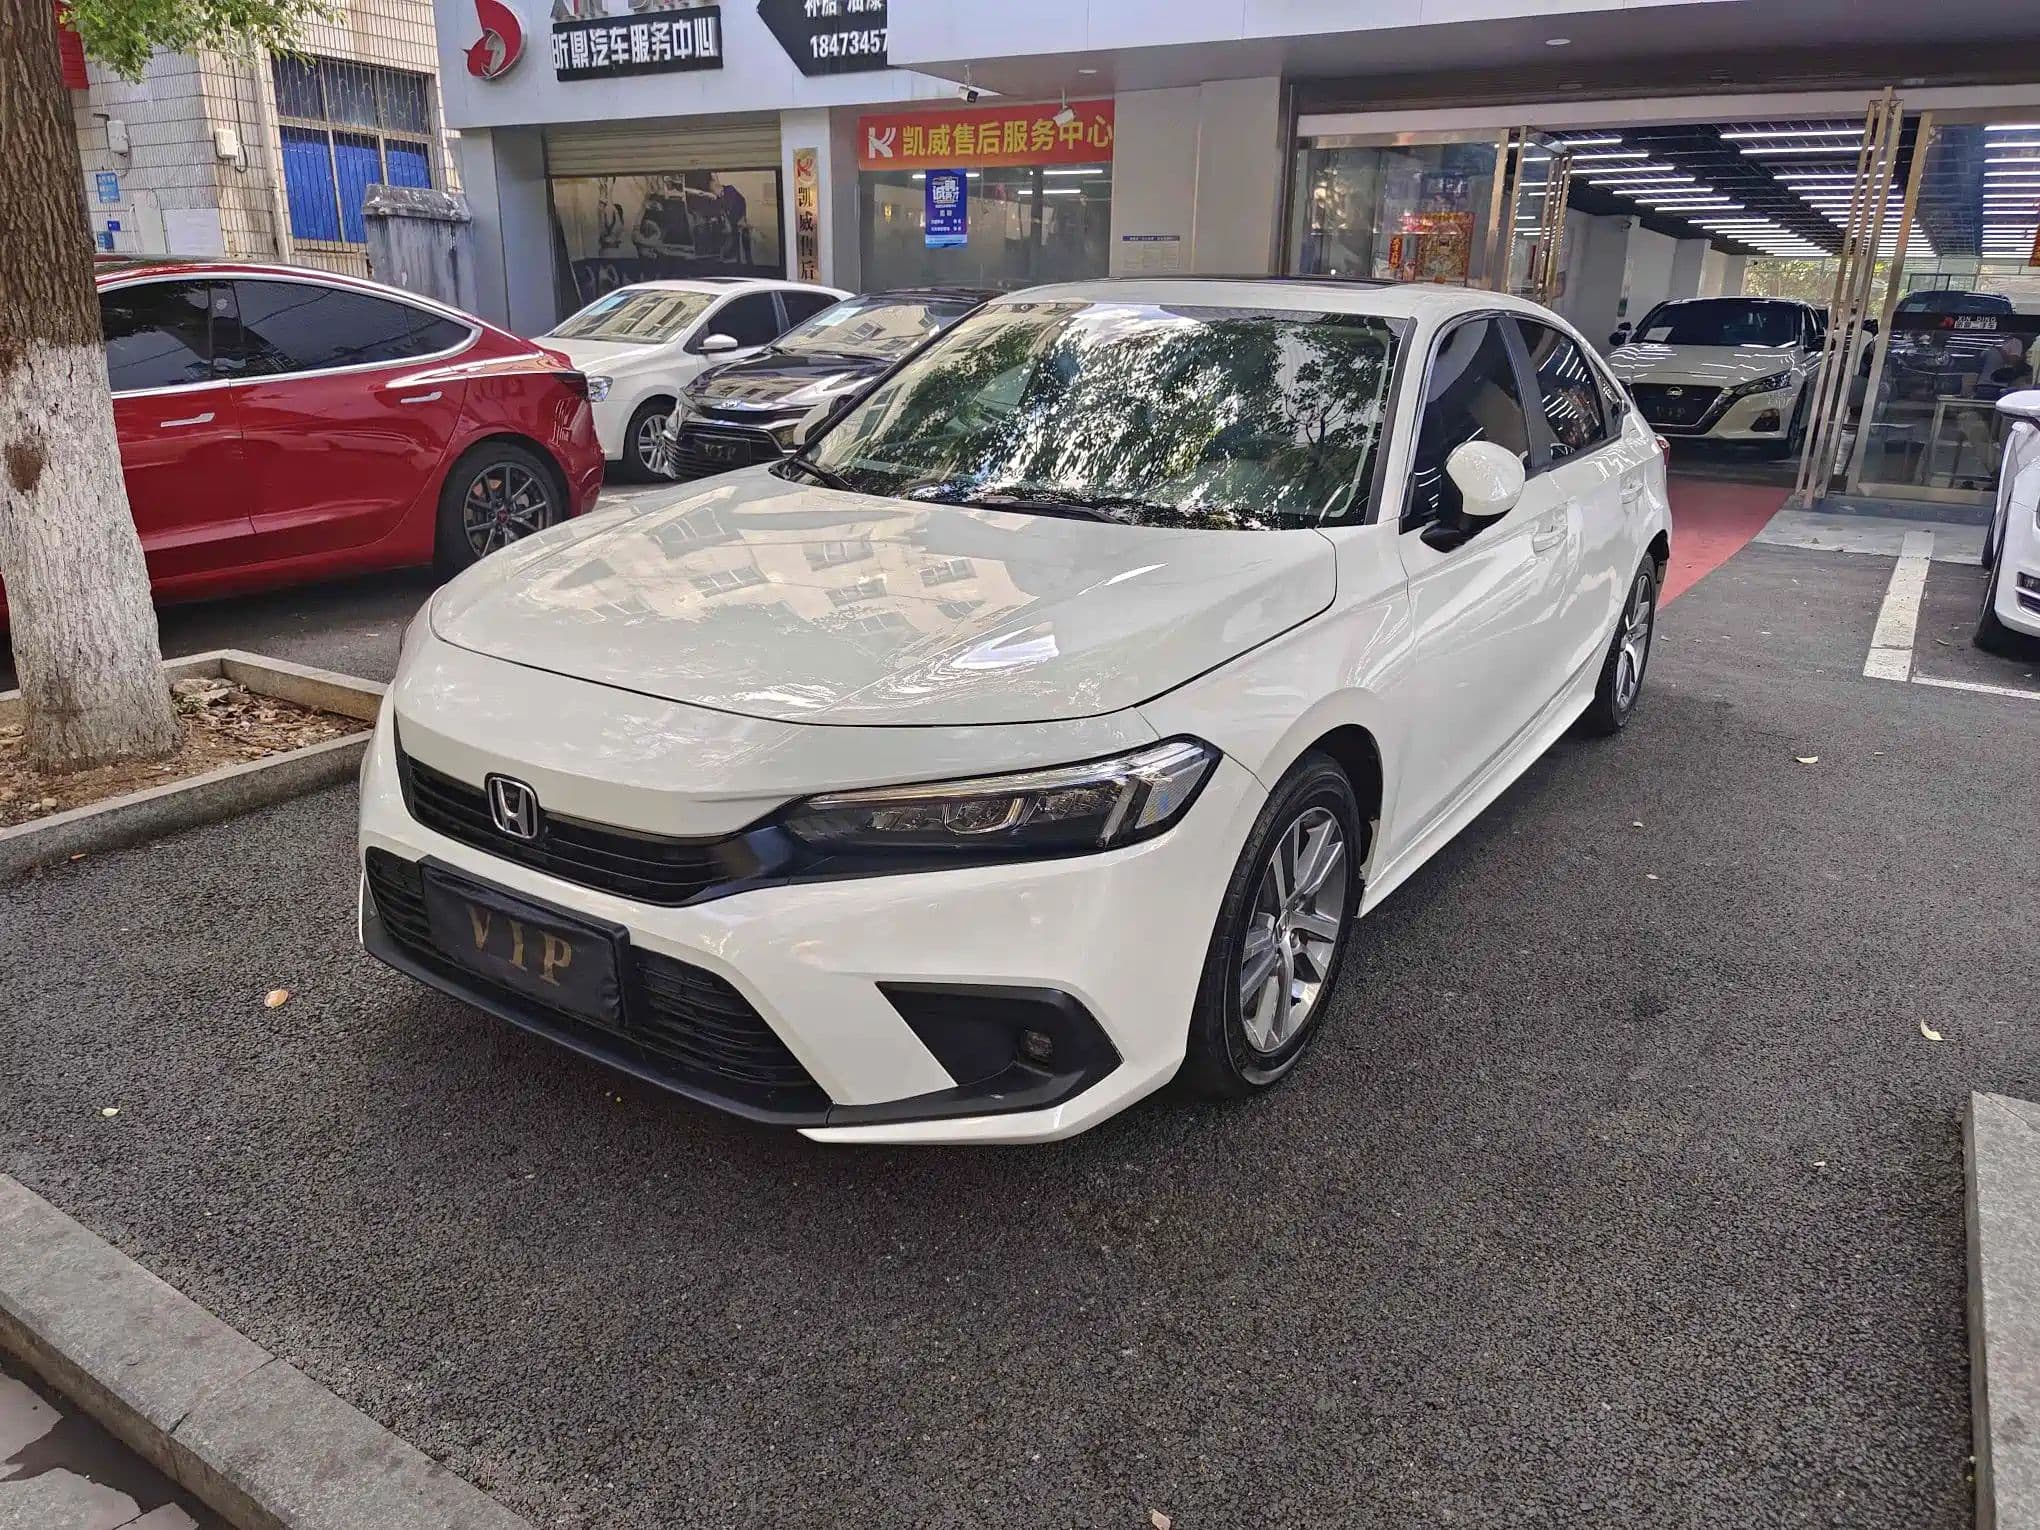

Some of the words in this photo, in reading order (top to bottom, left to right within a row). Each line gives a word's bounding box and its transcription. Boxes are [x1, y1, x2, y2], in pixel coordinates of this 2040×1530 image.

[810, 28, 887, 59] 18473457
[902, 115, 1113, 157] 凯威售后服务中心
[467, 903, 573, 987] VIP
